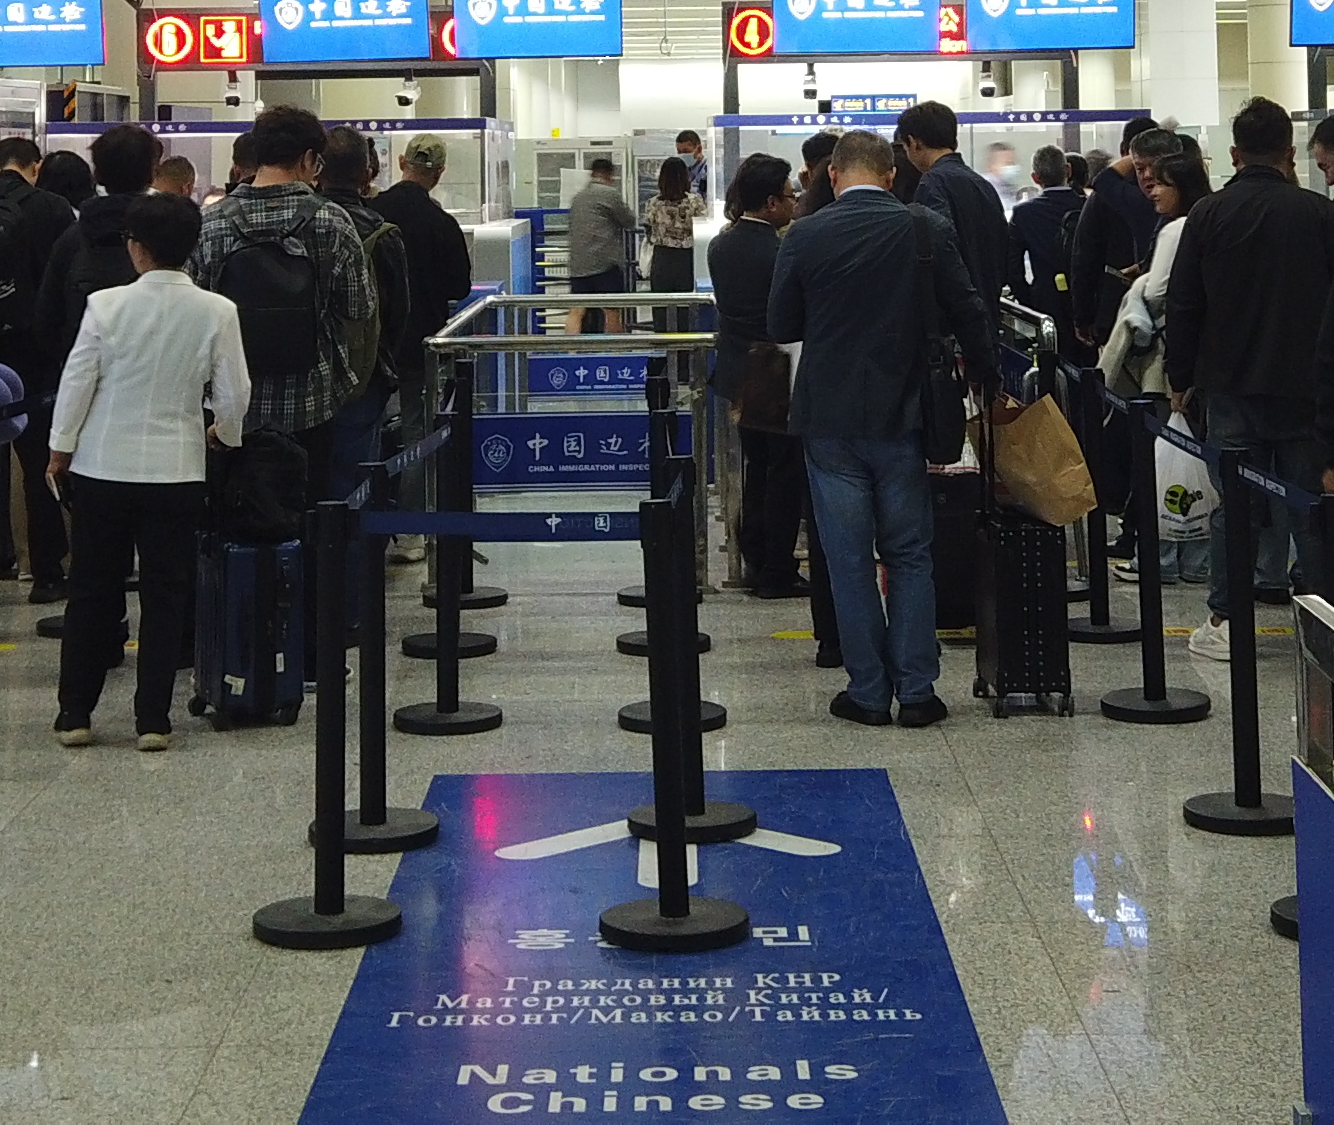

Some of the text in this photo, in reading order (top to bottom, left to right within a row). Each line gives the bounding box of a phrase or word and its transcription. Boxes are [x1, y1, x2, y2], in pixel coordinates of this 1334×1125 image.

[161, 23, 177, 56] 6
[744, 17, 760, 49] 4
[528, 465, 555, 473] CHINA
[558, 464, 616, 472] IMMIGRATION
[545, 513, 610, 534] 中国
[503, 973, 842, 994] Гражданин КНР
[434, 989, 727, 1009] Материковый
[386, 1006, 924, 1028] Гонконг/Макао/Тайвань
[457, 1058, 860, 1086] Nationals
[486, 1090, 826, 1115] Chinese
